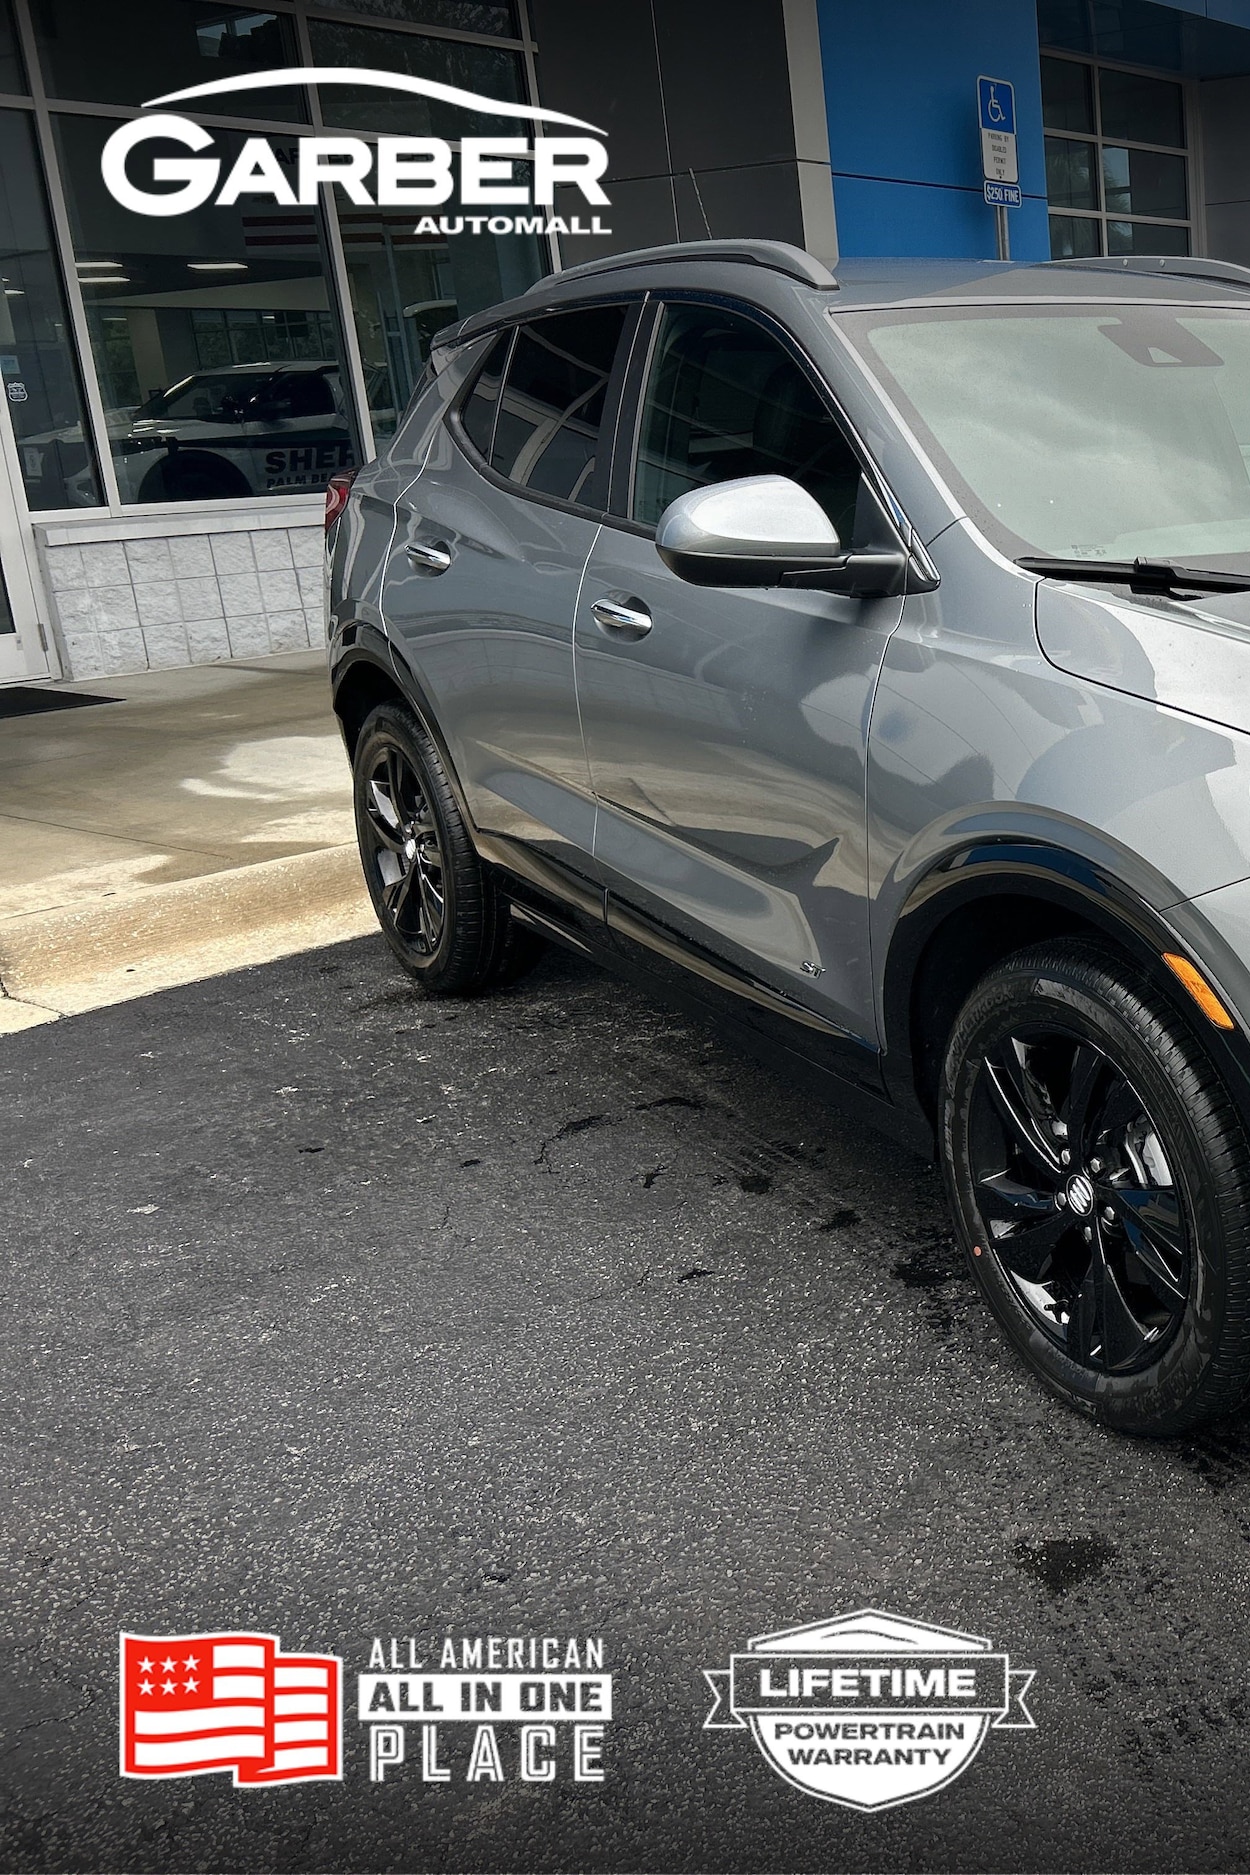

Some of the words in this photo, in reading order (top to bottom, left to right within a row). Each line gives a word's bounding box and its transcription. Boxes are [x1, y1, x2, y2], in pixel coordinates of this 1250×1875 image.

[986, 184, 1003, 202] $250
[1004, 188, 1019, 203] FINE
[266, 475, 307, 489] PALM
